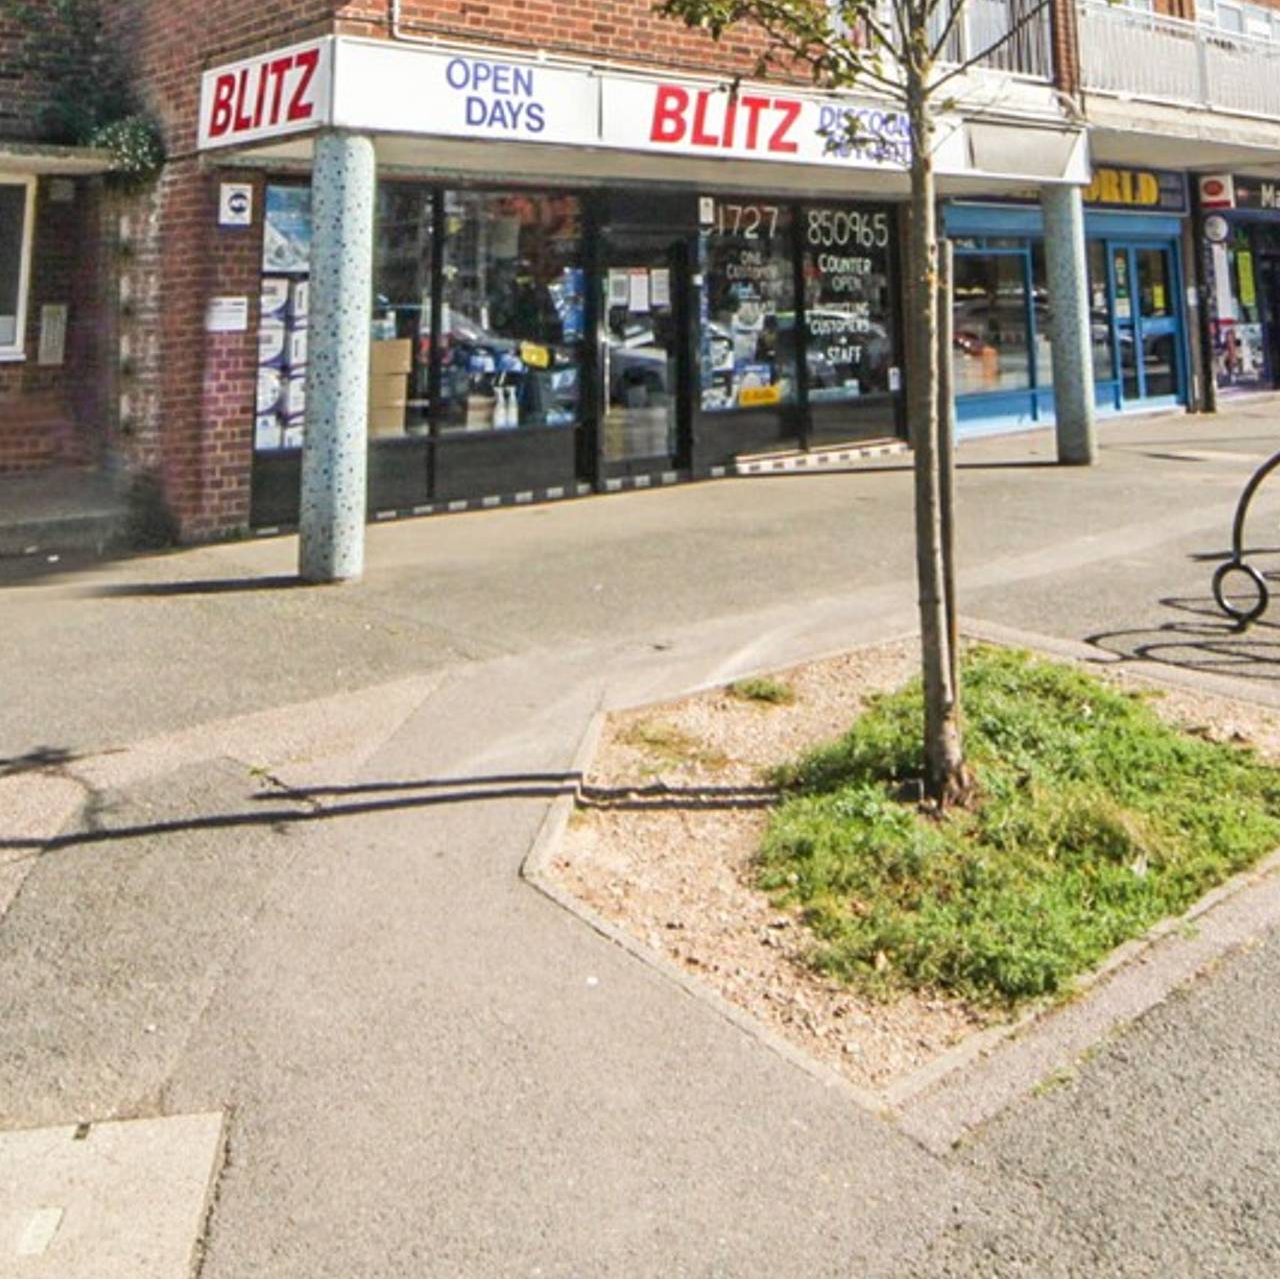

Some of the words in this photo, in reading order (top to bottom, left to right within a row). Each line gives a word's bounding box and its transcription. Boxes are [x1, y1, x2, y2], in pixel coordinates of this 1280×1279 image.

[208, 48, 320, 139] BLITZ
[446, 58, 533, 97] OPEN
[466, 96, 545, 133] DAYS
[650, 84, 802, 153] BLITZ
[820, 106, 912, 136] DISCOUN
[1082, 168, 1160, 206] ORLD
[700, 204, 779, 239] 1727
[807, 210, 889, 248] 850965
[818, 253, 872, 275] COUNTER
[831, 276, 863, 292] OPEN
[826, 345, 863, 366] STAFF
